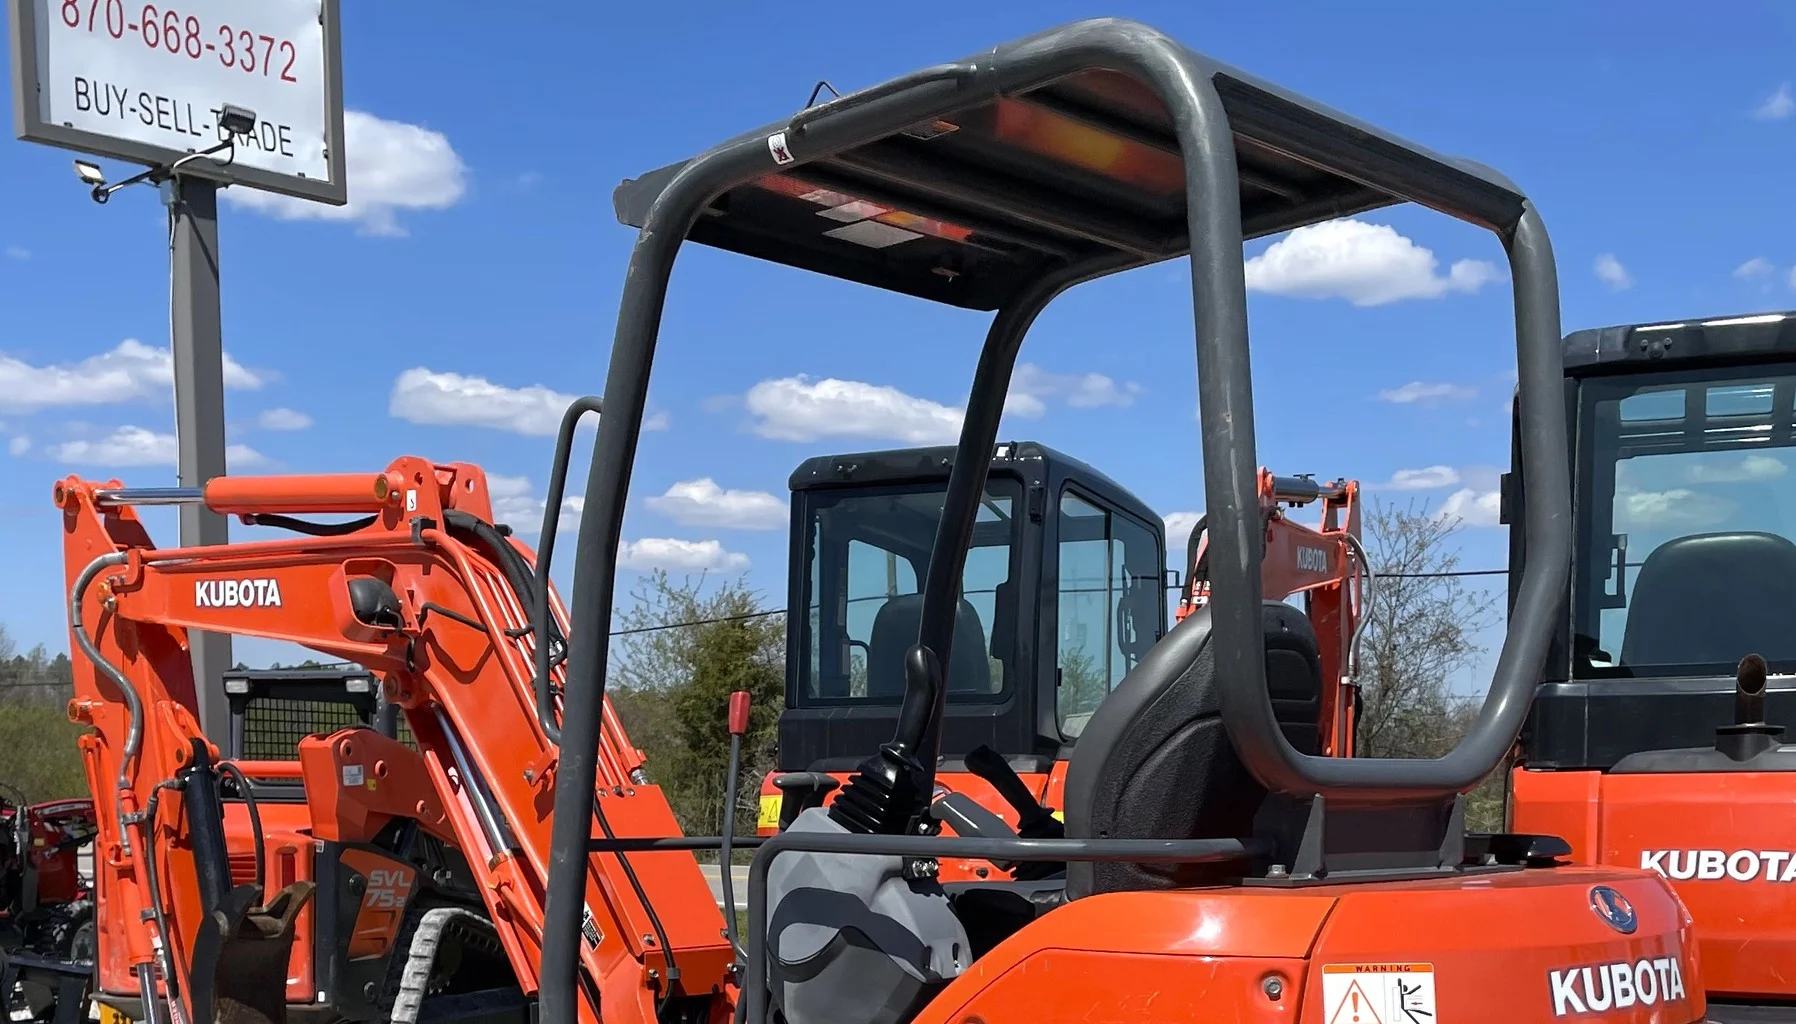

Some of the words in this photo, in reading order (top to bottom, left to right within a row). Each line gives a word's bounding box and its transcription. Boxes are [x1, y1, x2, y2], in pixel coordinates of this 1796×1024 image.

[74, 76, 294, 158] BUY-SELL-TADE
[1296, 545, 1328, 574] KUBOTA
[195, 578, 282, 607] KUBOTA
[368, 869, 412, 888] SVL
[1355, 964, 1411, 973] WARNING
[1550, 957, 1686, 1016] KUBOTA
